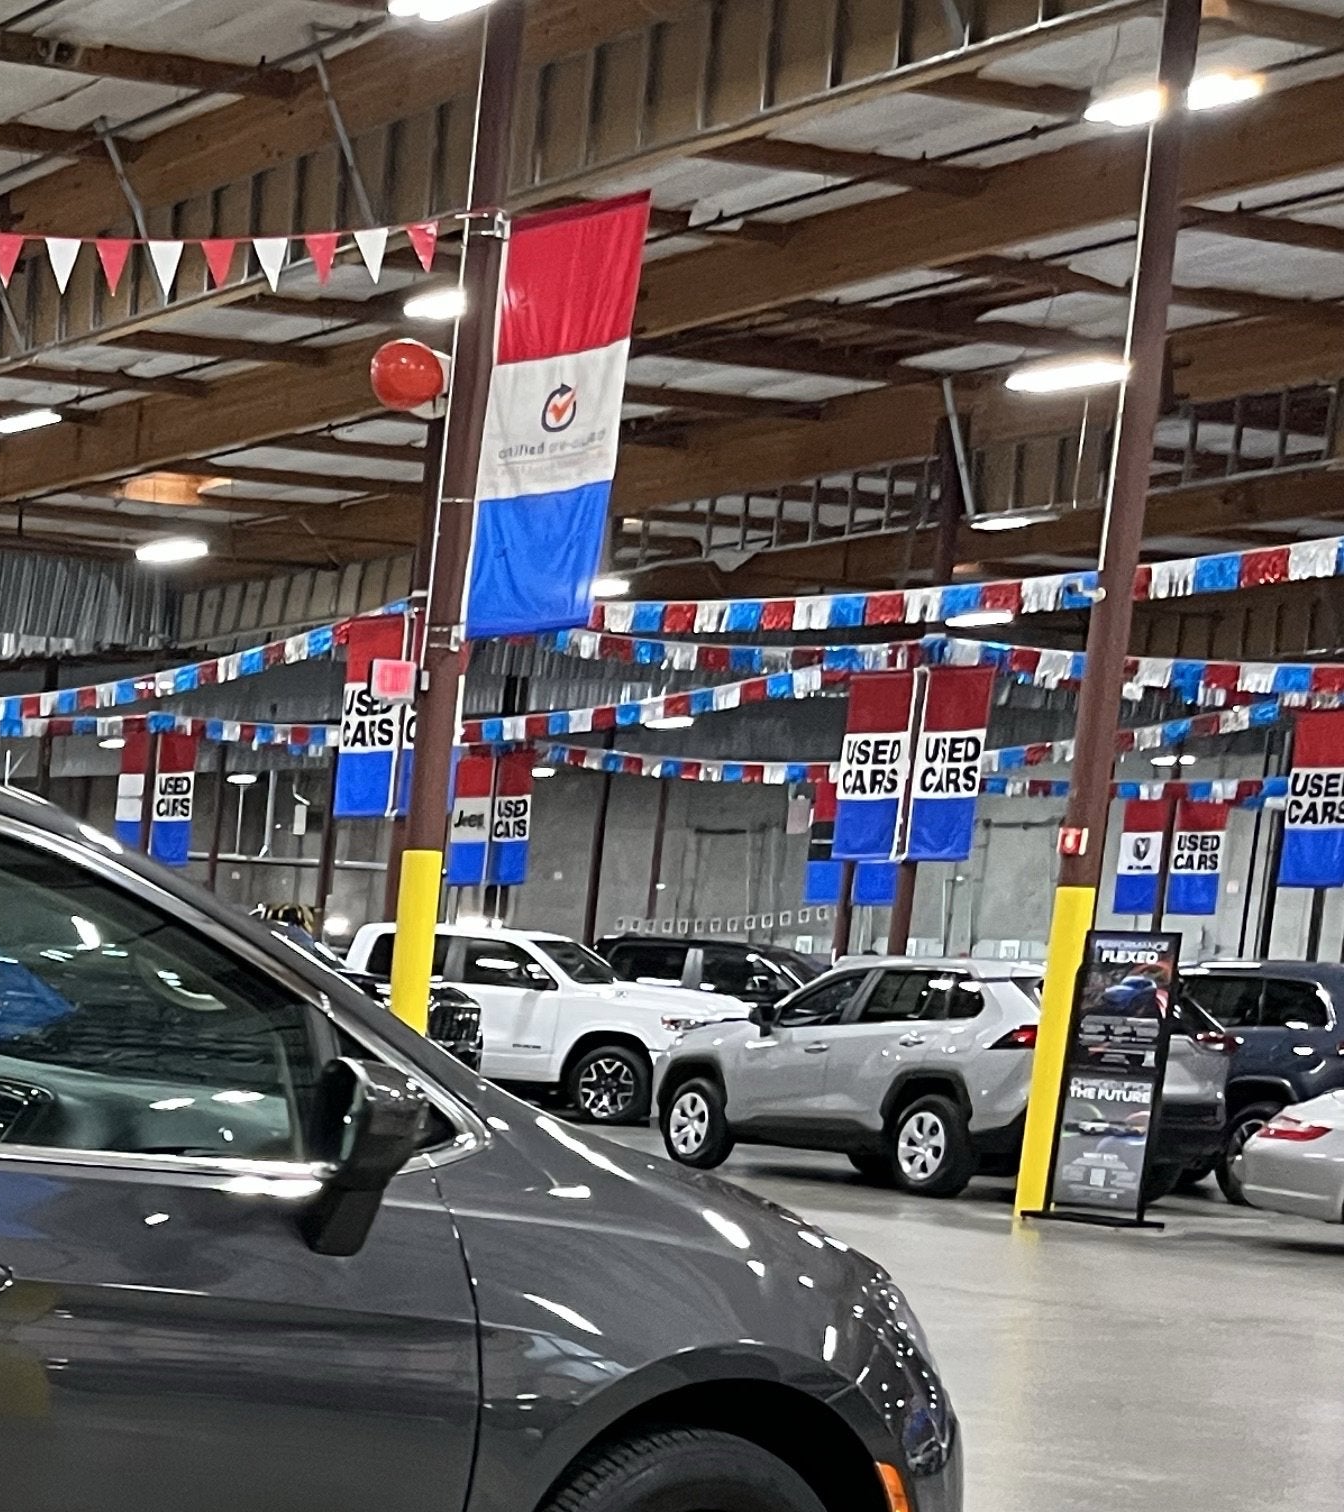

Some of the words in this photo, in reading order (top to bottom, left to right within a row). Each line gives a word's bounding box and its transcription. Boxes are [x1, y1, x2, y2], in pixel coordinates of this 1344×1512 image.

[343, 718, 394, 747] CARS
[847, 739, 901, 765] USED
[925, 736, 981, 764] USED
[158, 776, 192, 796] USED
[843, 768, 898, 795] CARS
[920, 765, 978, 793] CARS
[1291, 772, 1344, 798] USE
[1177, 834, 1221, 852] USED
[1173, 853, 1219, 871] CARS
[1101, 950, 1159, 965] FLEXED
[1069, 1084, 1097, 1100] THE
[1097, 1087, 1152, 1104] FUTURE
